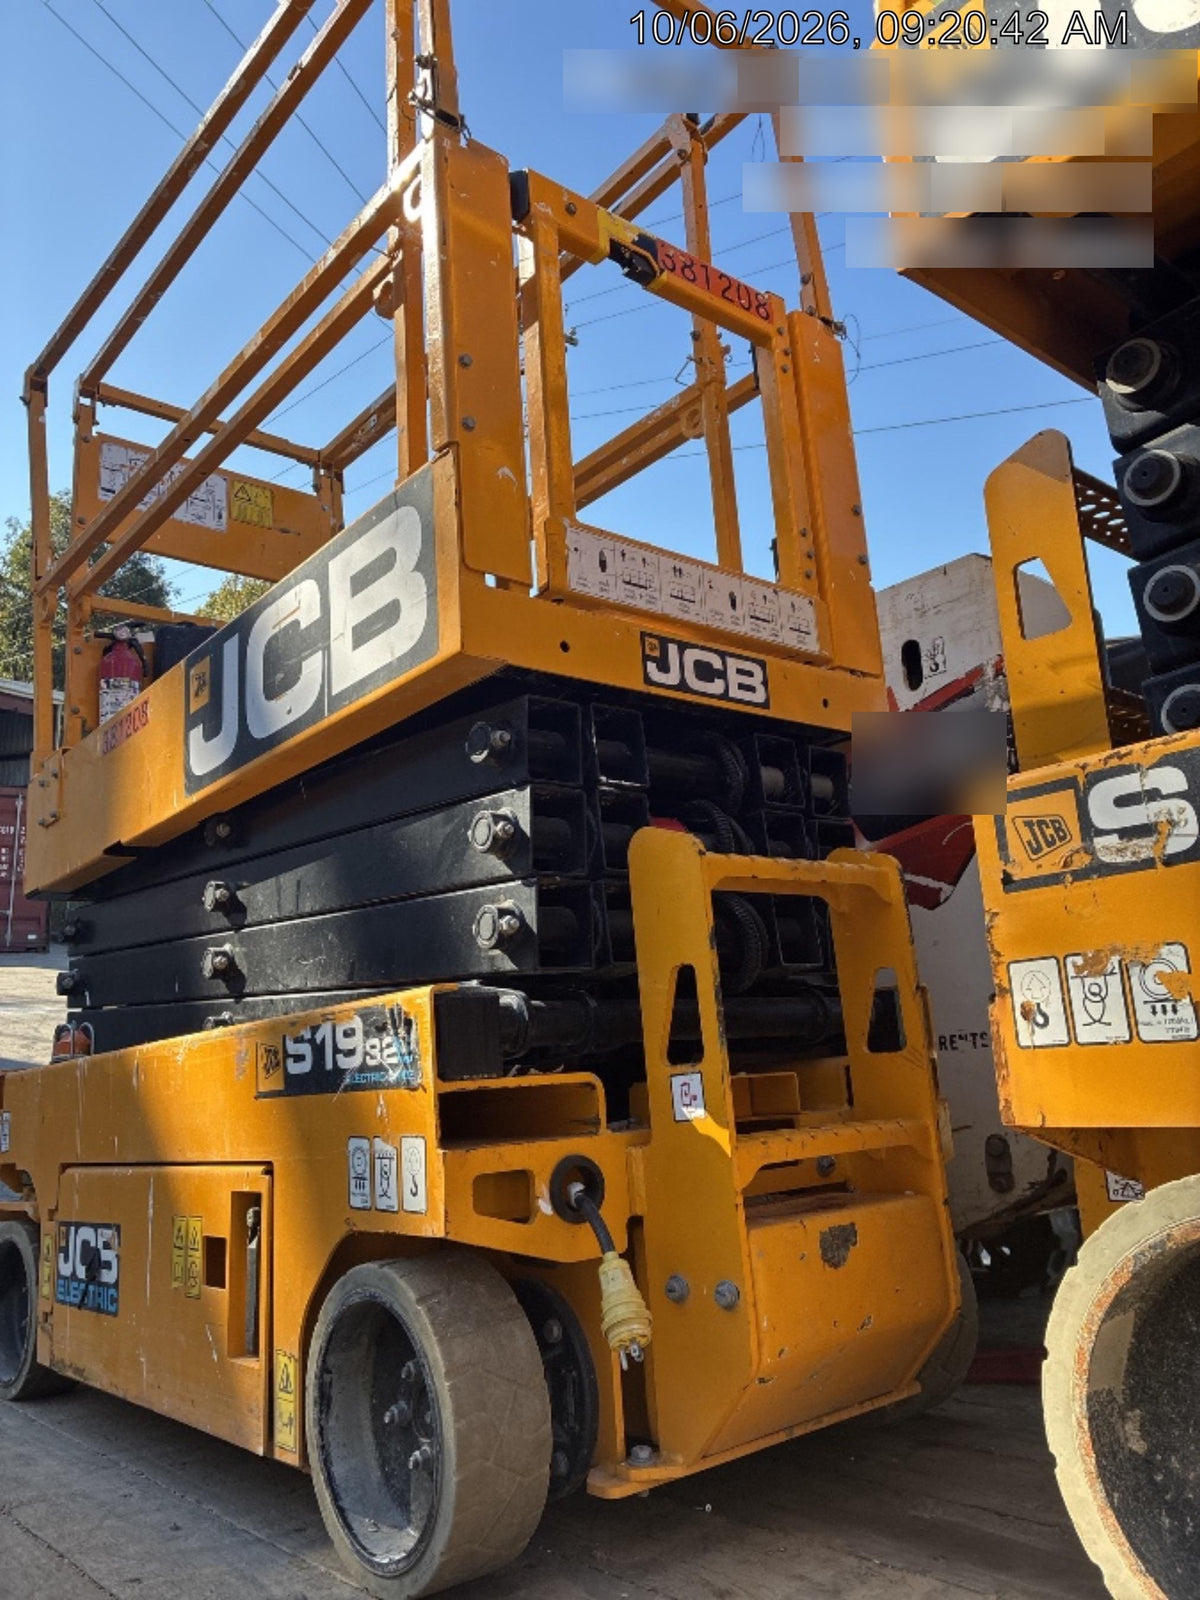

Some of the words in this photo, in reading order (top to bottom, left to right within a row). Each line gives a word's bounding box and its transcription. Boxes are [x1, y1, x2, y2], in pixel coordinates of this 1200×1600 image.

[189, 505, 428, 776] JCB
[646, 643, 767, 703] JCB
[1022, 819, 1068, 855] JCB
